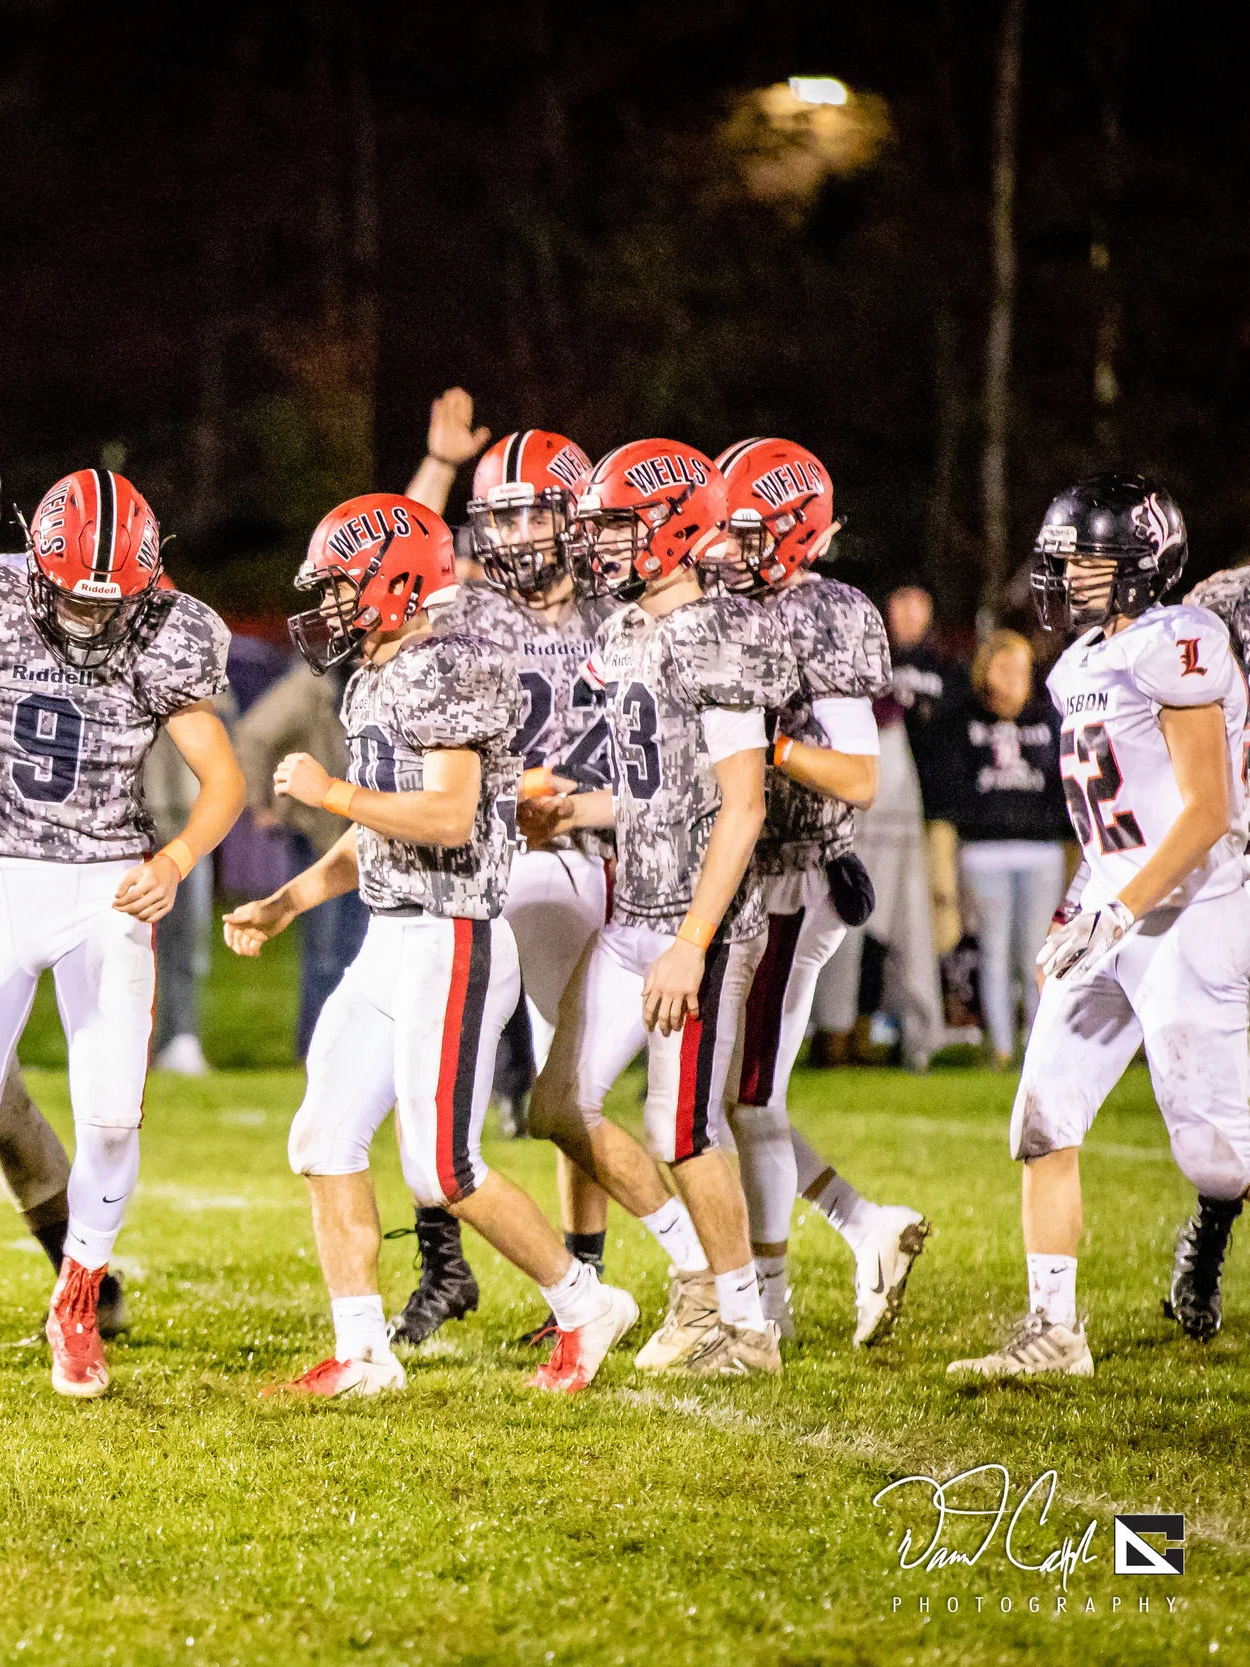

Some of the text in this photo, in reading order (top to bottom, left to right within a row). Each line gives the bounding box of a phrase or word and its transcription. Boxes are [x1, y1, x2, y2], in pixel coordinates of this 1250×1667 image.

[624, 455, 709, 498] WELLS
[752, 461, 825, 510] WELLS
[39, 479, 68, 558] WELLS
[327, 507, 411, 562] WELLS
[81, 583, 117, 594] Riddell
[523, 642, 594, 657] Riddell
[12, 664, 93, 687] Riddell
[1064, 692, 1109, 718] ISBON
[10, 692, 85, 805] 9
